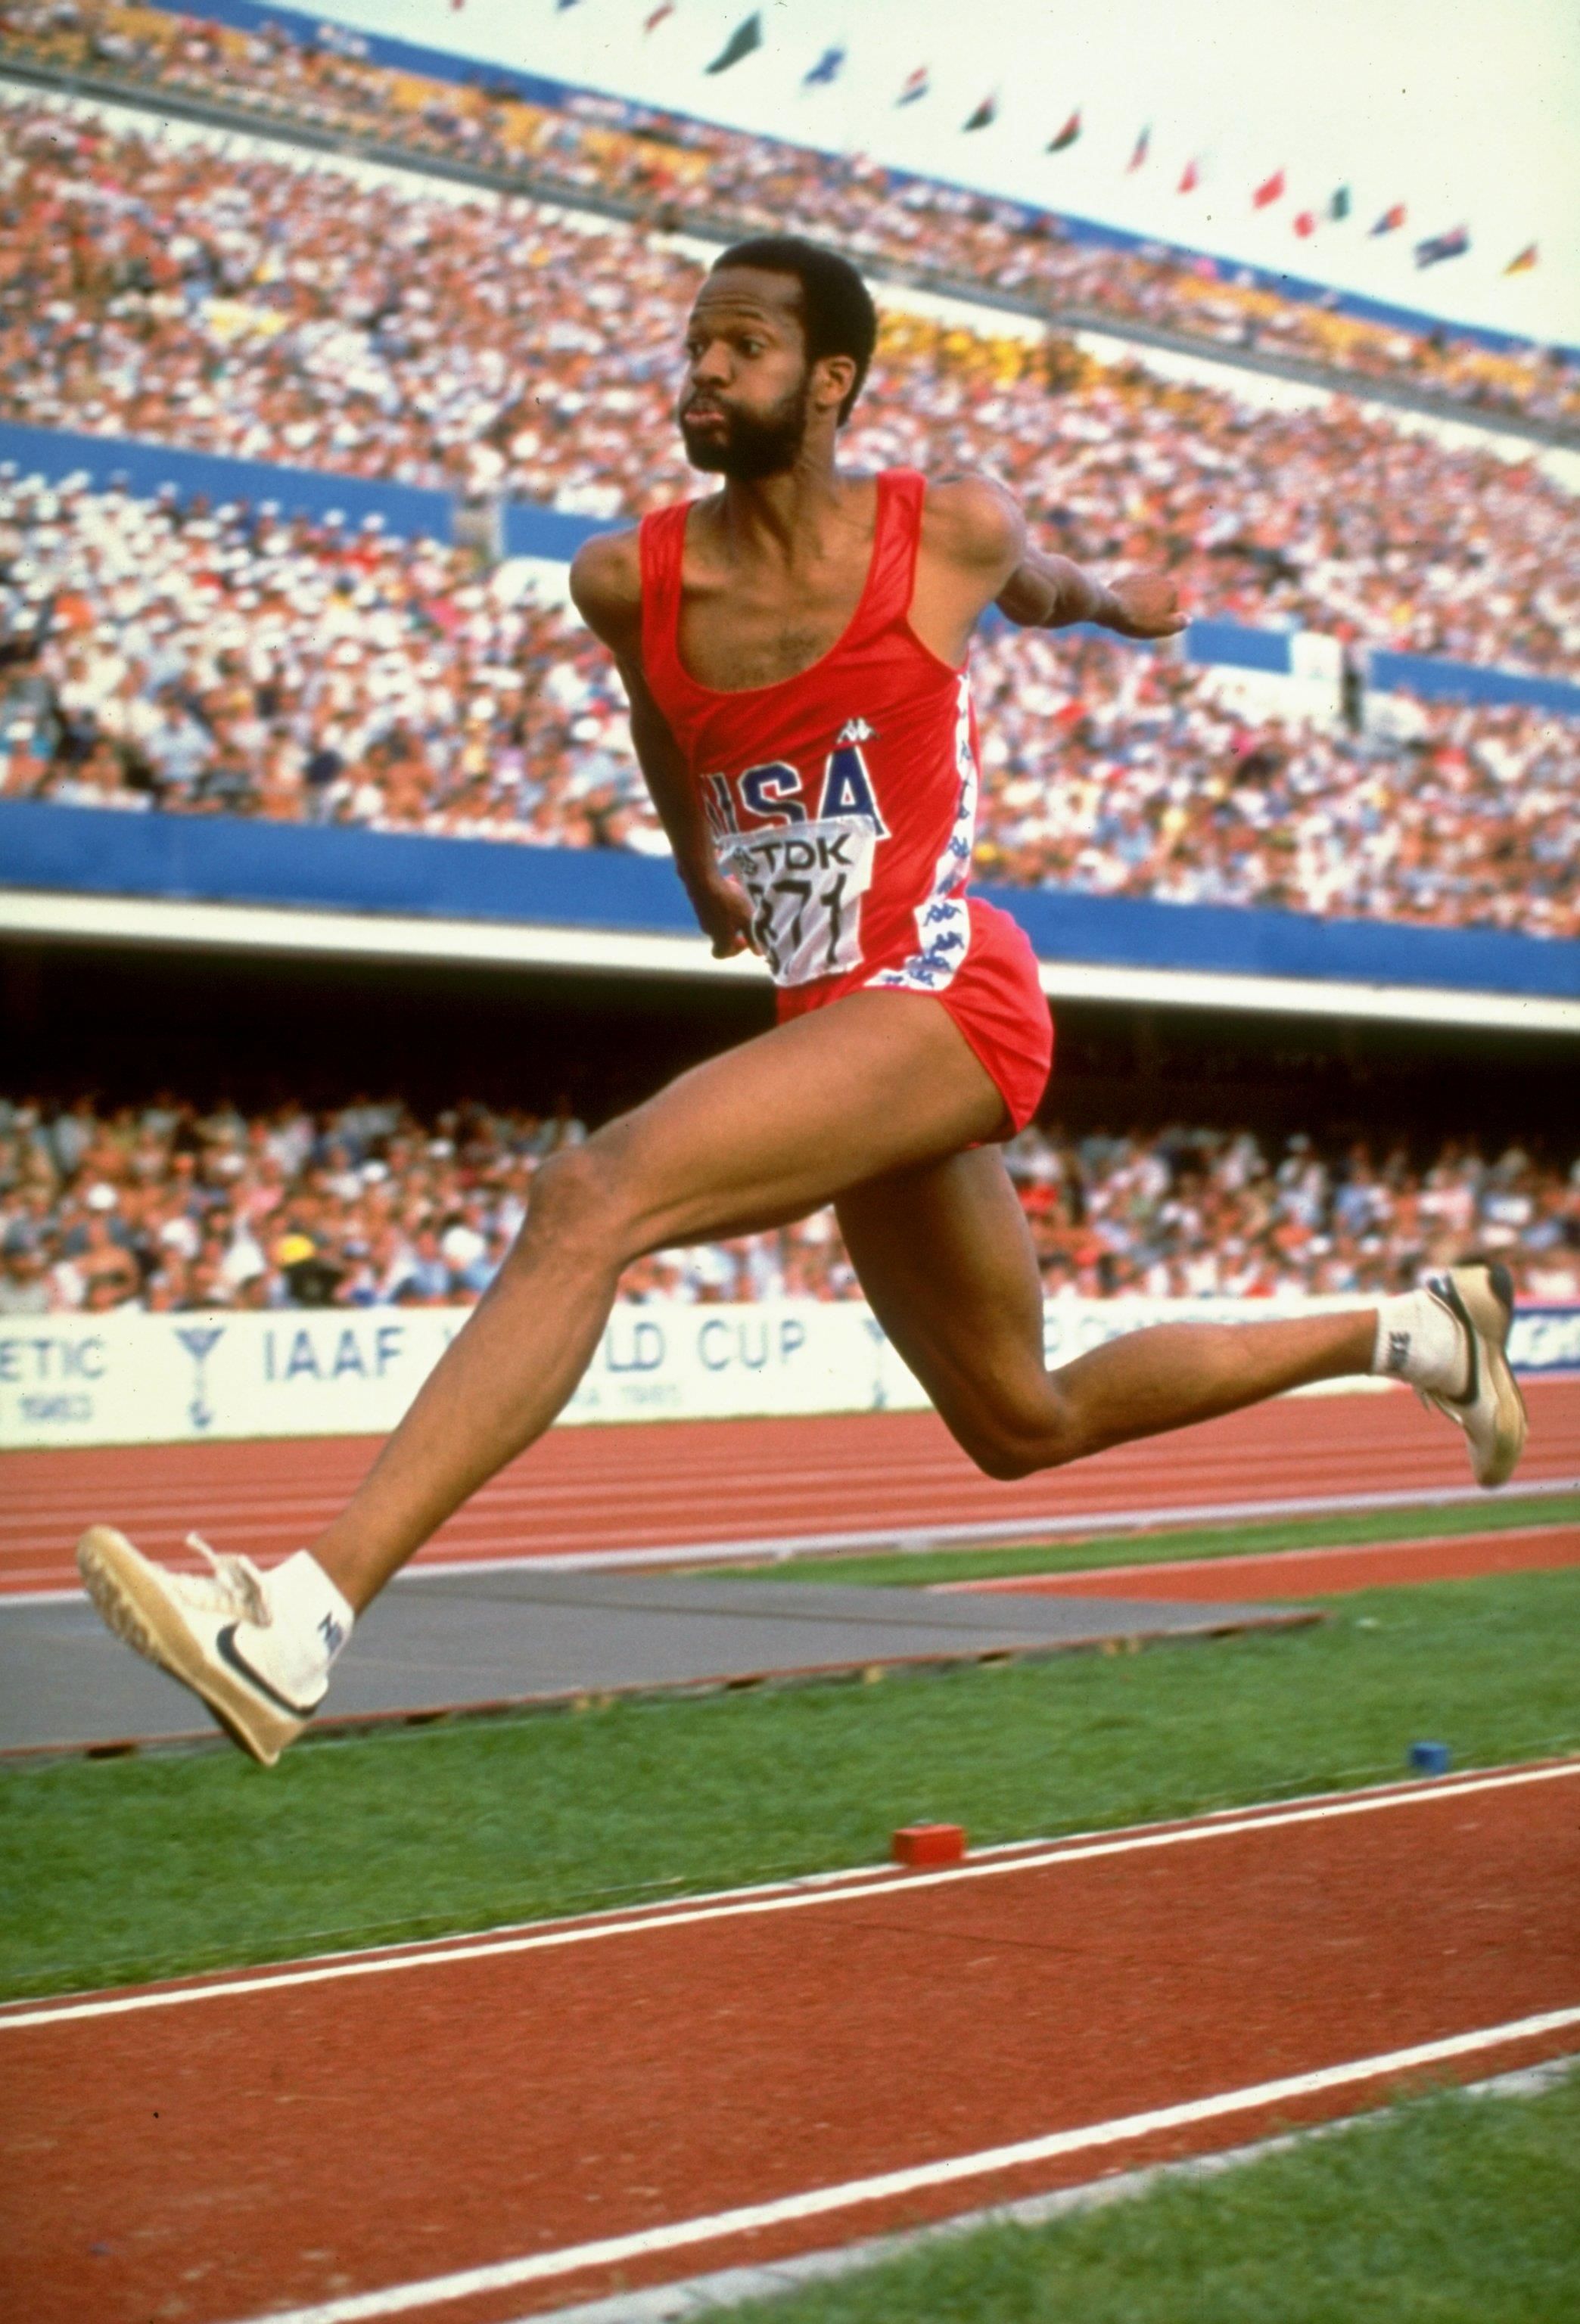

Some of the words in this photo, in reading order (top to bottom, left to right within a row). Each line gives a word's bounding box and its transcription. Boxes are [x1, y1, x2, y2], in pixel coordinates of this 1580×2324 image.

[750, 833, 854, 873] TDK
[265, 1327, 405, 1381] IAAF
[697, 1319, 807, 1372] CUP
